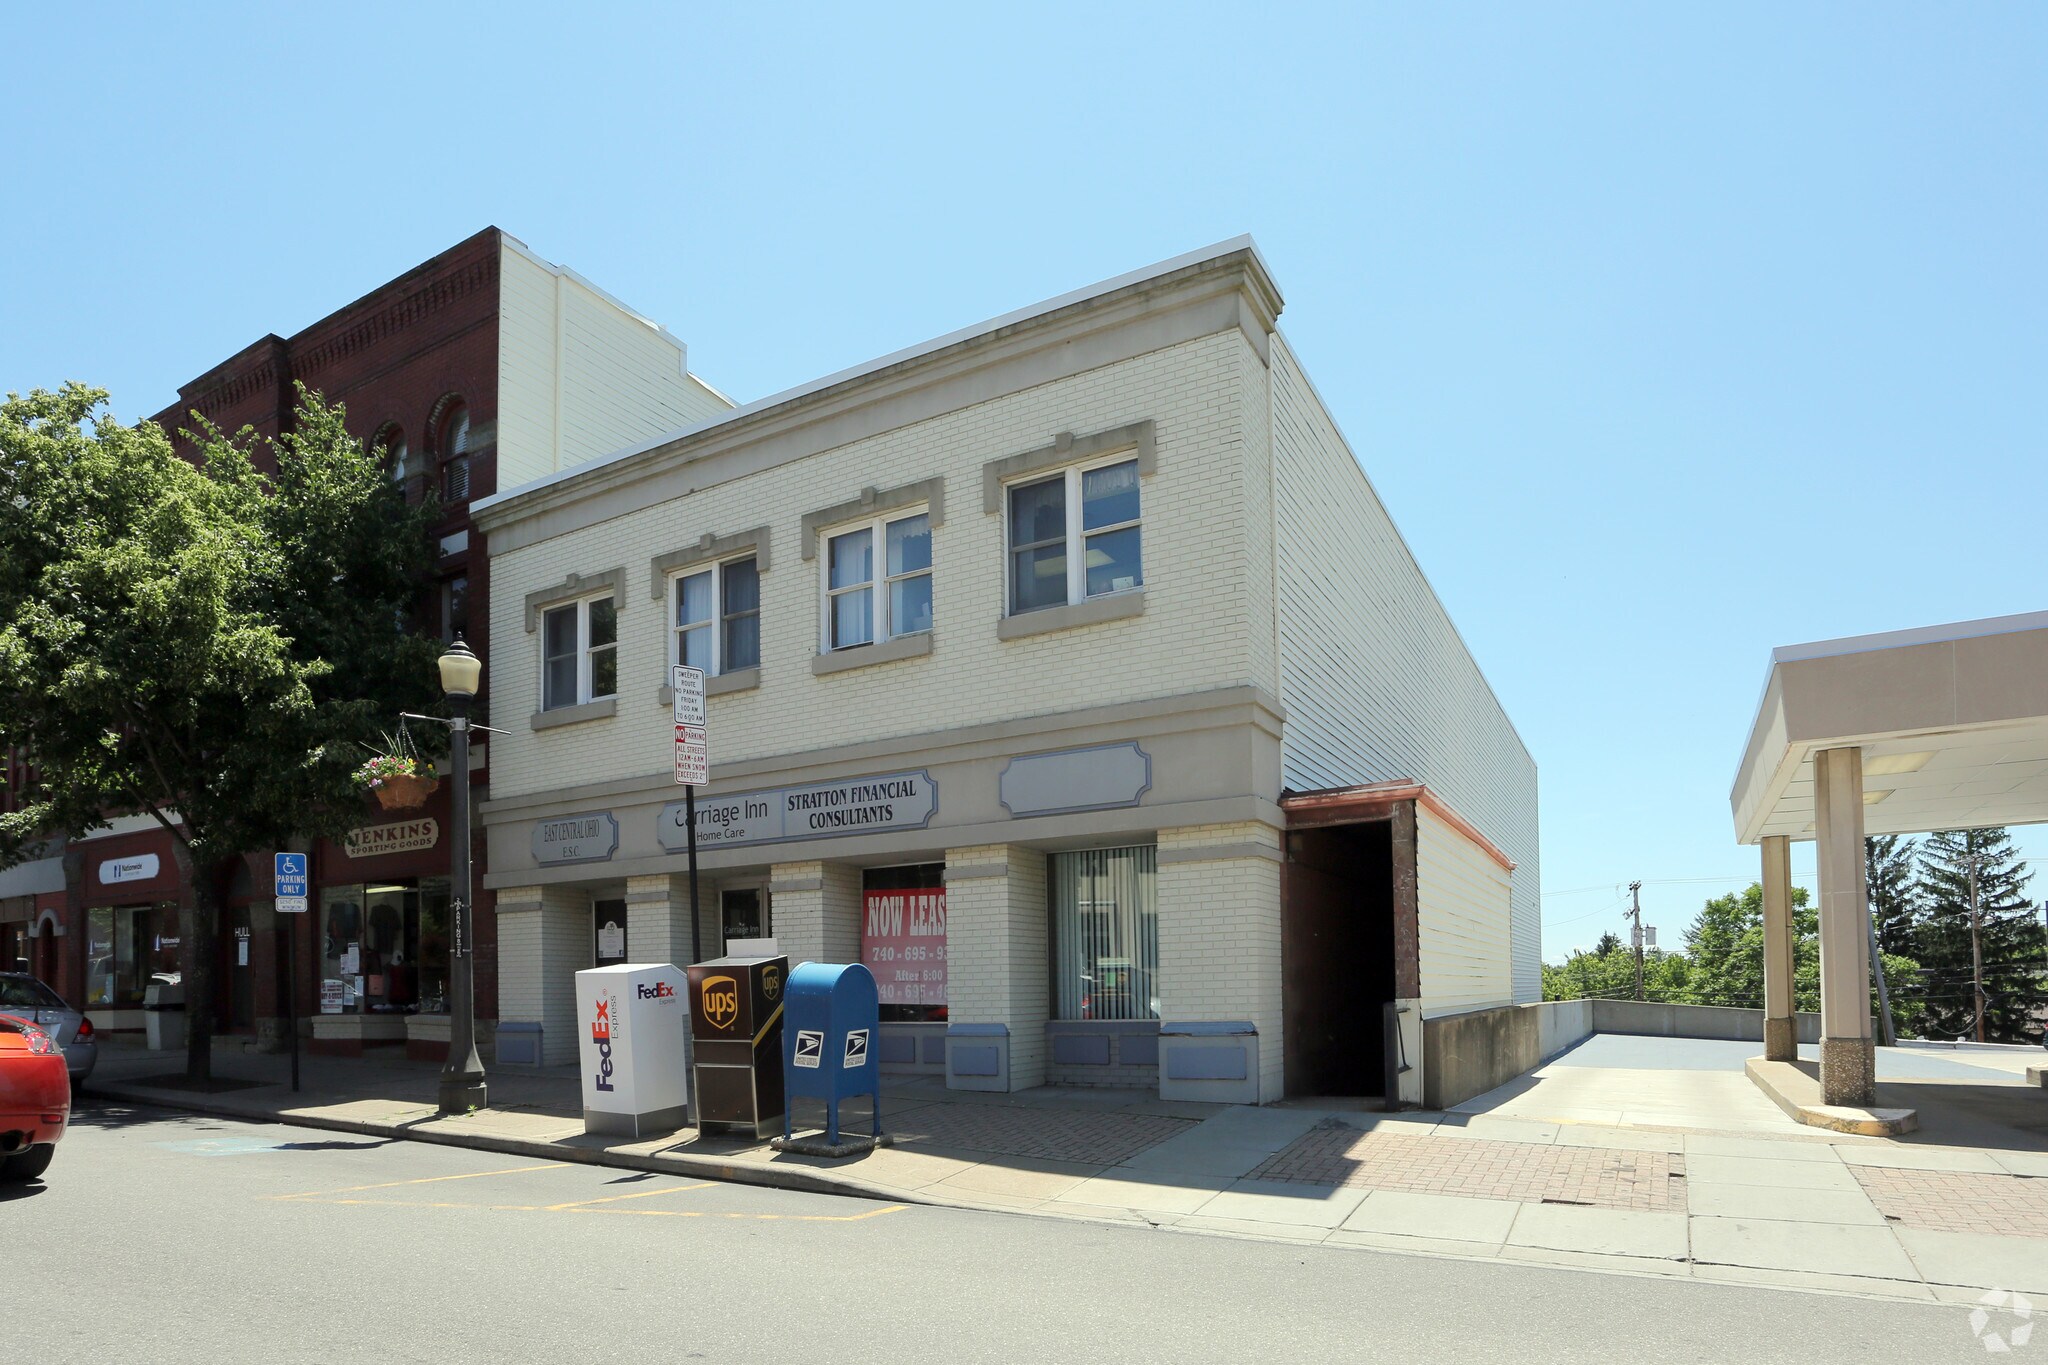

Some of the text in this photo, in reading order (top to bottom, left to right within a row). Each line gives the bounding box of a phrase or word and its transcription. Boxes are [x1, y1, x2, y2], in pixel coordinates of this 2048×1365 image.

[678, 671, 699, 680] SWEEPER
[681, 680, 696, 688] ROUTE
[683, 688, 703, 697] PARKING
[675, 729, 705, 742] NO PARKING
[677, 745, 705, 755] ALL STREETS
[677, 762, 706, 772] WHEN SNOW
[677, 770, 698, 780] EXCEEDS
[788, 780, 917, 811] STRATTON FINANCIAL
[675, 799, 768, 827] Crriage Inn
[809, 804, 893, 829] CONSULTANTS
[354, 822, 431, 845] JENKINS
[544, 818, 600, 842] EAST CENTRAL OHIO
[696, 828, 745, 842] Home Care
[351, 837, 432, 855] SPORTING GOODS
[277, 874, 305, 884] PARKING
[282, 885, 300, 894] ONLY
[867, 895, 946, 937] NOW LEAS
[872, 947, 895, 961] 740
[904, 946, 926, 961] 695
[895, 970, 943, 982] After 6:00
[638, 982, 673, 999] FedEx
[764, 976, 779, 995] ups
[877, 984, 895, 998] 40
[705, 993, 735, 1021] ups
[611, 995, 619, 1039] Express
[592, 1000, 614, 1093] FedEx
